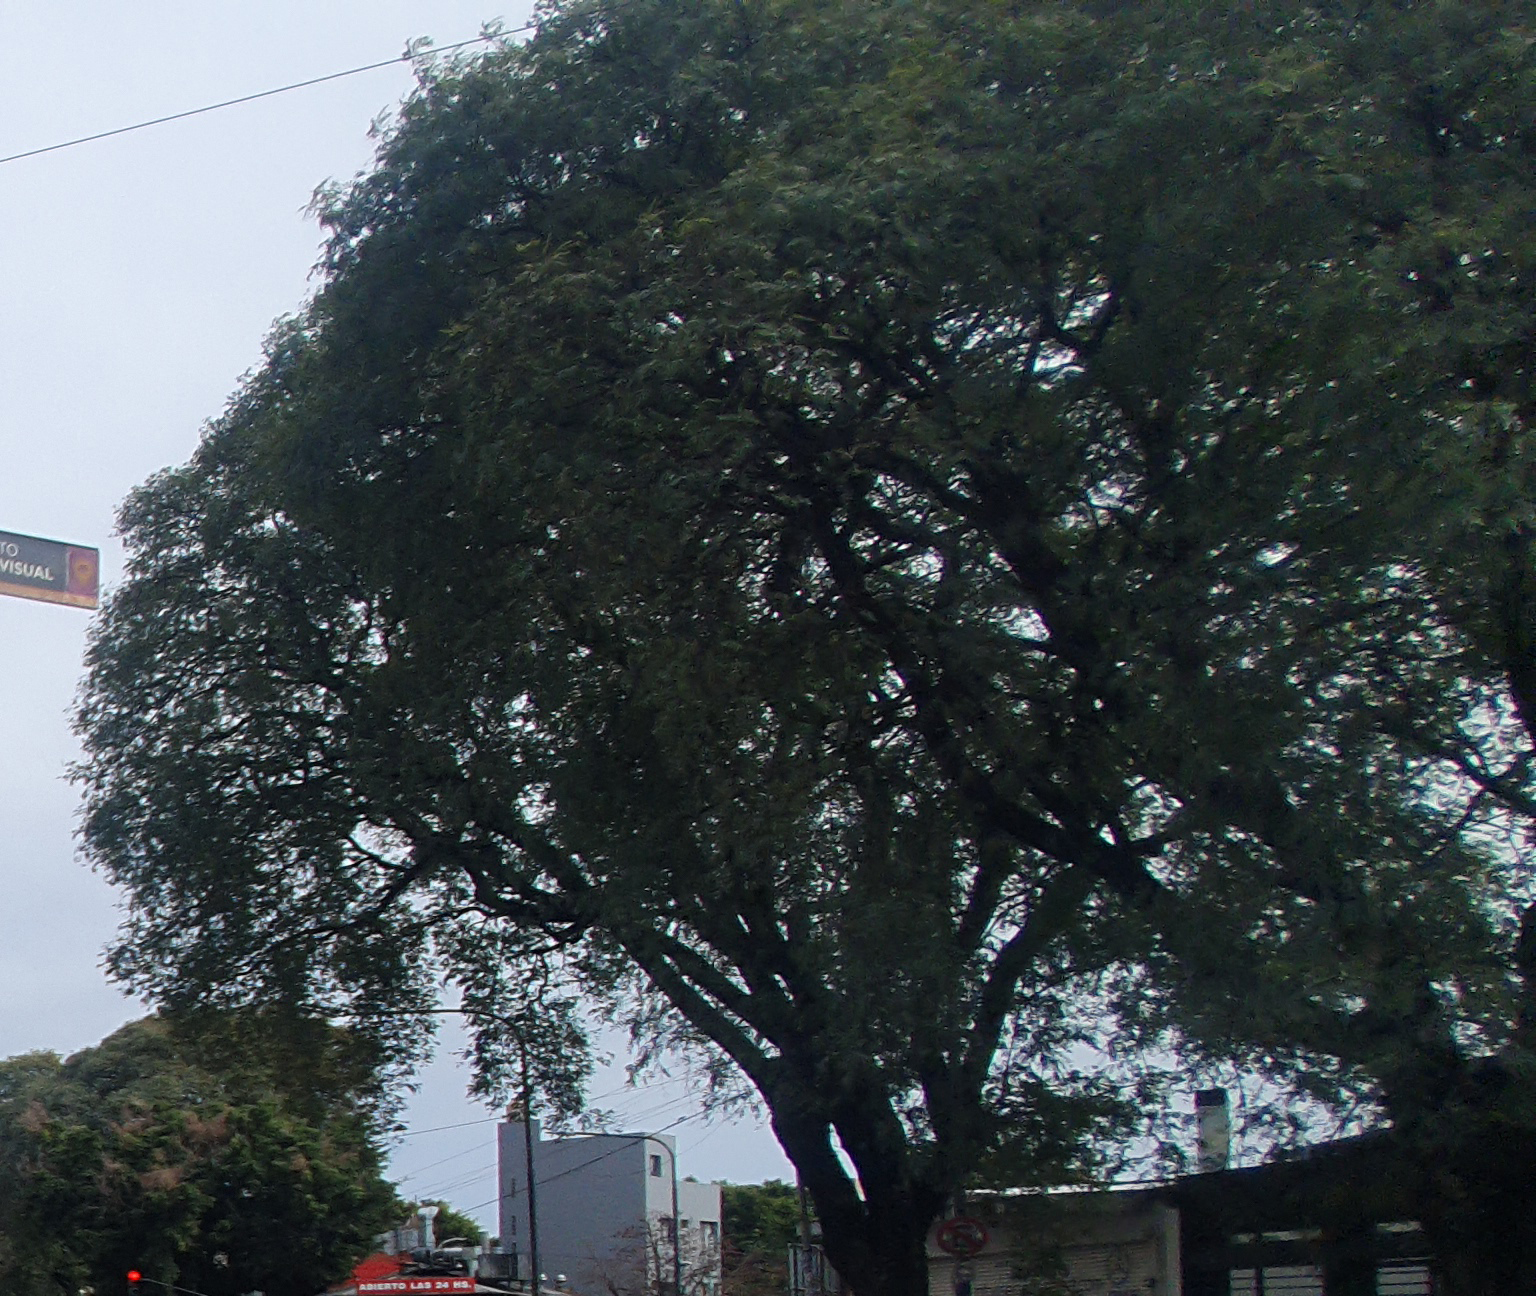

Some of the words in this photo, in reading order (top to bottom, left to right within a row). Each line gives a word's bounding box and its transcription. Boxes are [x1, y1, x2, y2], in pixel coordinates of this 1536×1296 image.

[359, 1282, 406, 1291] ABIERTO
[410, 1281, 431, 1290] LAS
[436, 1281, 449, 1289] 24
[453, 1280, 472, 1289] HS.
